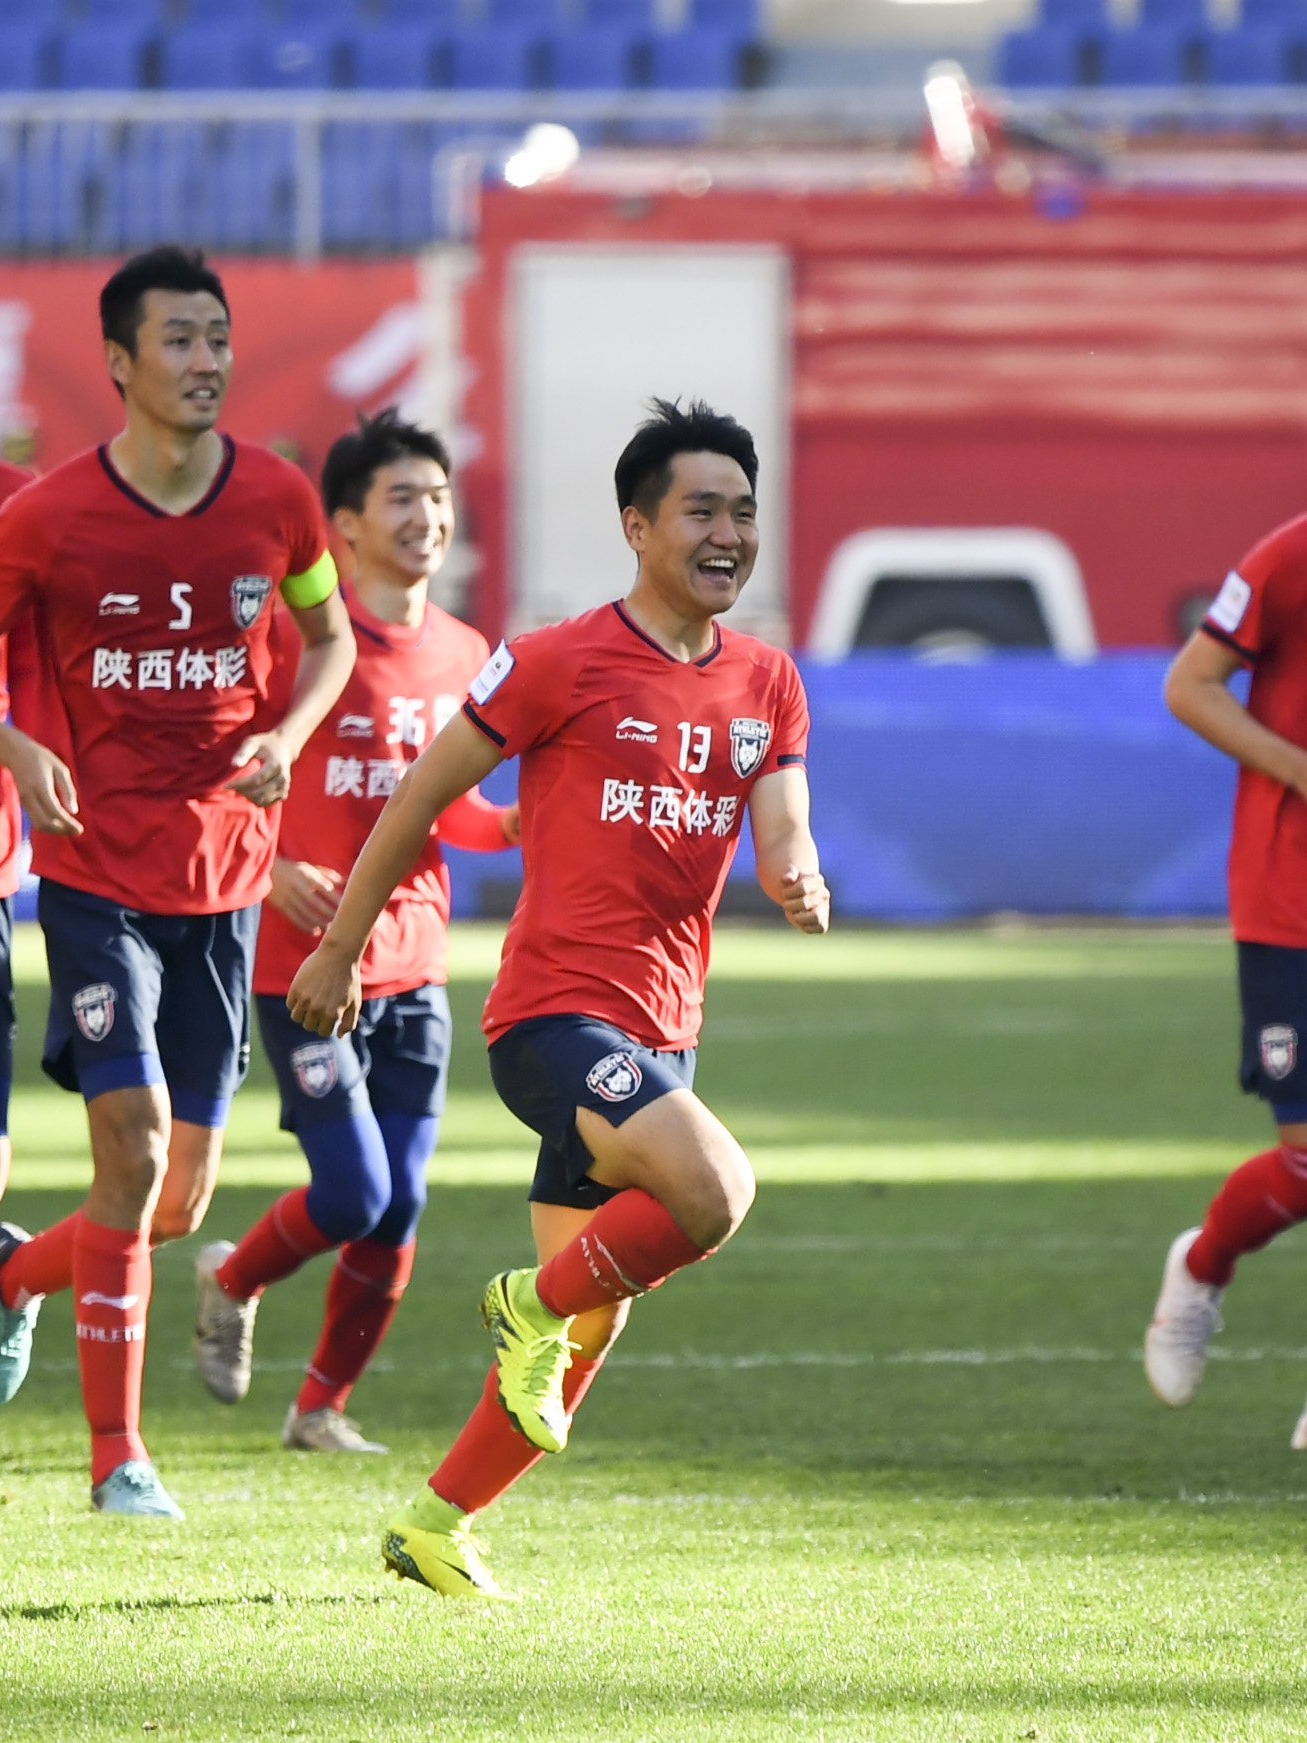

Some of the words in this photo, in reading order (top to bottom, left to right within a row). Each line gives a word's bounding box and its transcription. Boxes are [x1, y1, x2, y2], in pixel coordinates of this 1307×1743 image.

[169, 582, 193, 630] 5
[92, 645, 247, 690] 陕西体彩
[677, 721, 712, 774] 13
[600, 778, 742, 838] 陕西体彩
